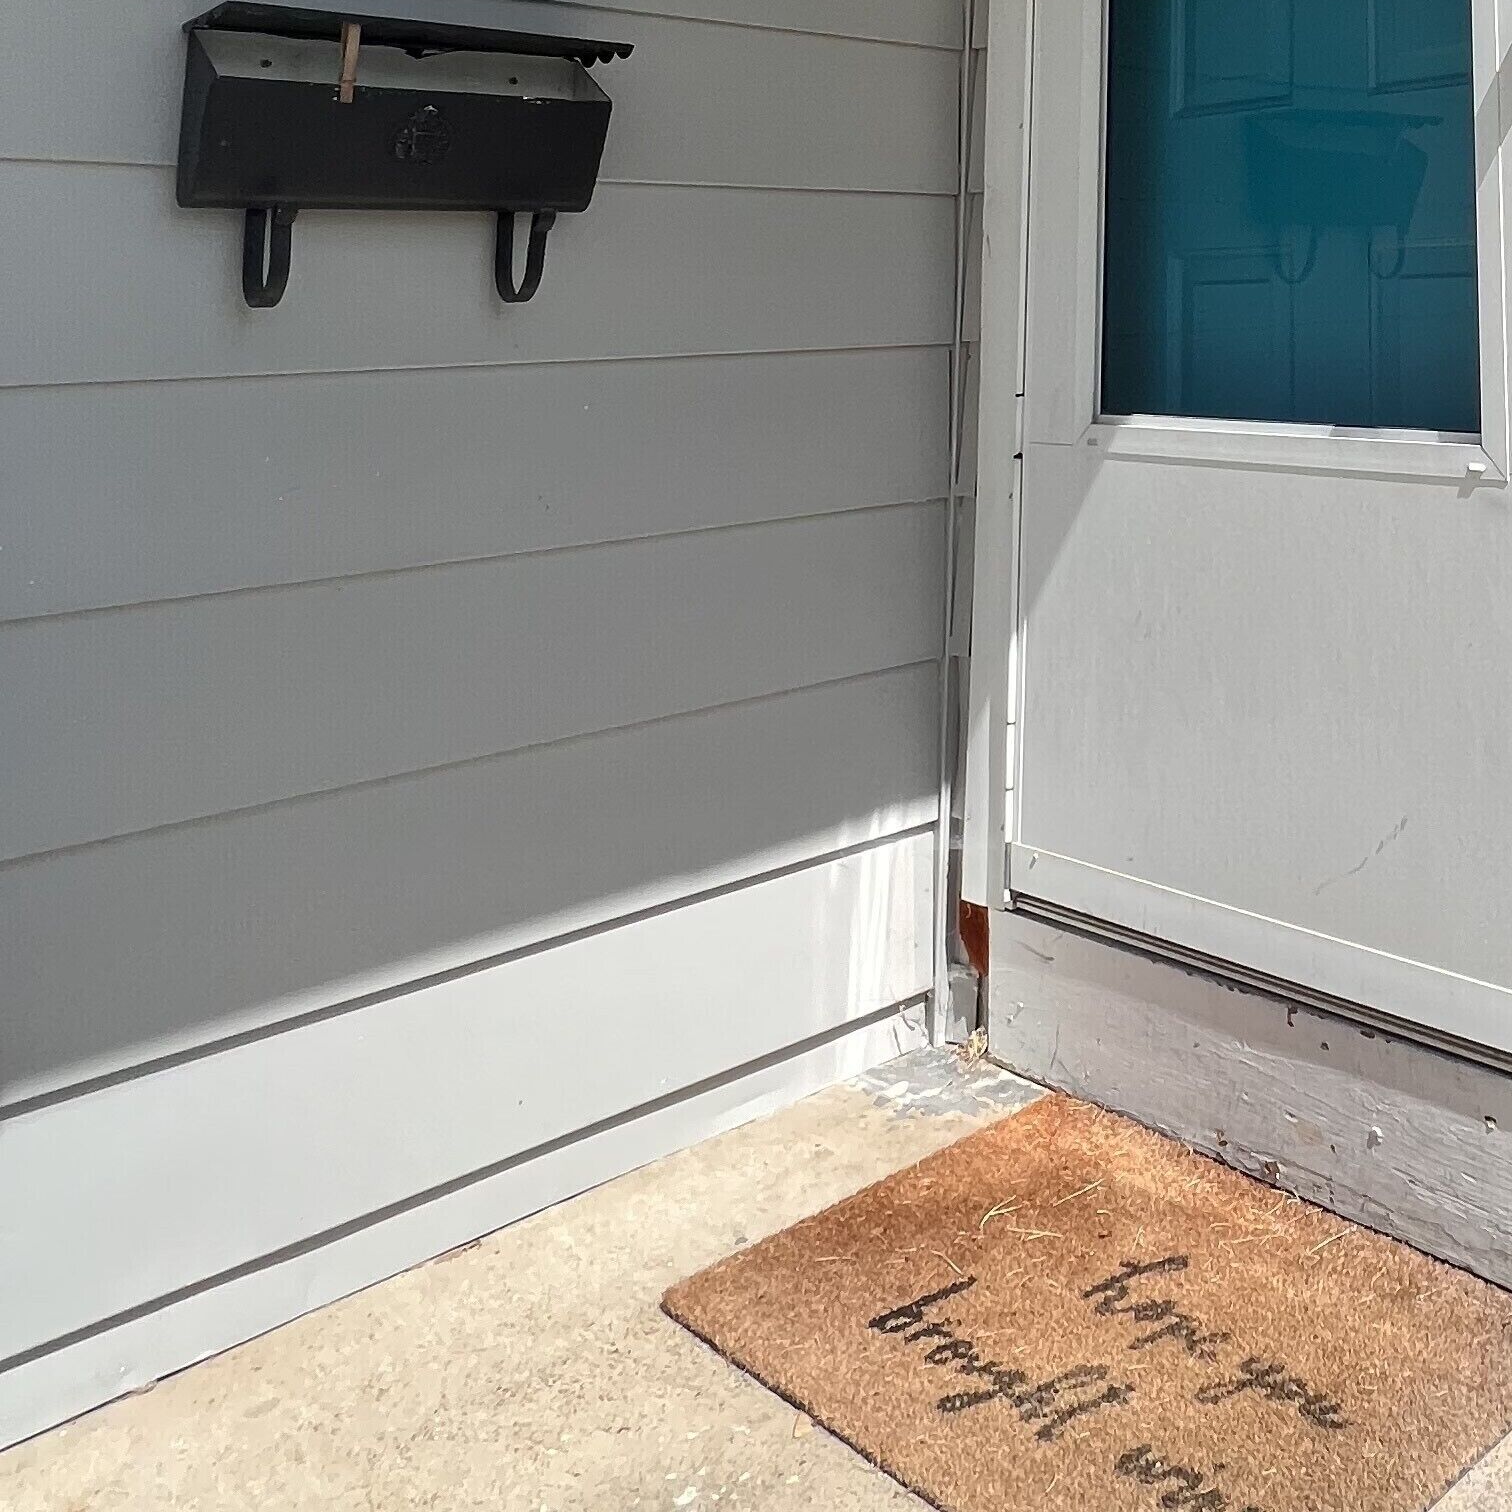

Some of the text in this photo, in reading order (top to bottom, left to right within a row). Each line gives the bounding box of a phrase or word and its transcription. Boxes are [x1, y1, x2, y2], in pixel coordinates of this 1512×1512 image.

[868, 1277, 1136, 1441] brought
[1082, 1255, 1350, 1429] hope you
